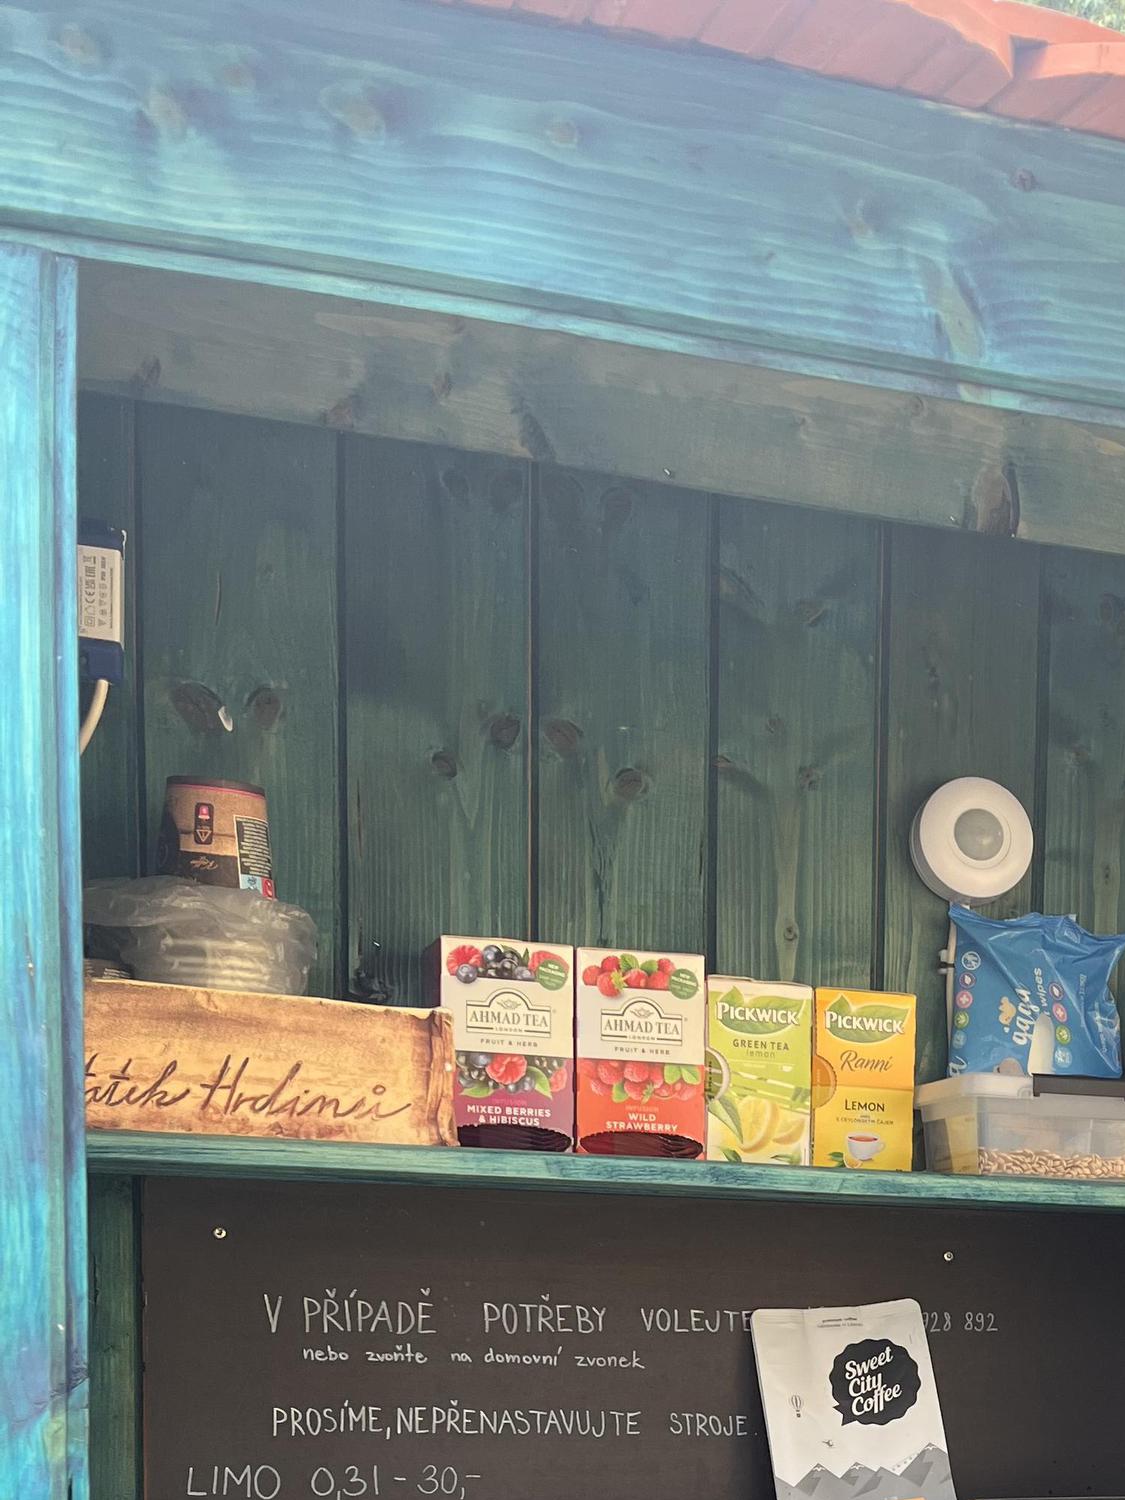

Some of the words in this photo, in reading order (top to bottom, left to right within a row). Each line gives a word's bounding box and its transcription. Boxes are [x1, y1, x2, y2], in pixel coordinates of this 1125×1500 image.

[470, 1010, 521, 1027] AHMAD
[523, 1013, 549, 1028] TEA
[717, 1002, 799, 1026] PICKWICK
[825, 1011, 904, 1034] PICKWICK
[604, 1018, 652, 1034] AHMAD
[655, 1021, 680, 1036] TEA
[480, 1038, 505, 1046] FRUIT
[614, 1046, 638, 1054] FRUIT
[733, 1038, 767, 1050] GREEN
[770, 1041, 789, 1051] TEA
[746, 1049, 776, 1059] lemon
[840, 1050, 893, 1072] Ranní
[467, 1104, 502, 1115] MIXED
[506, 1106, 551, 1118] BERRIES
[844, 1099, 885, 1112] LEMON
[478, 1115, 485, 1123] &
[489, 1116, 540, 1127] HIBISCUS
[628, 1112, 656, 1122] WILD
[606, 1121, 678, 1132] STRAWBERRY
[263, 1293, 283, 1333] V
[303, 1287, 437, 1334] PŘÍPADĚ
[482, 1293, 607, 1334] POTŘEBY
[641, 1307, 752, 1334] VOLEJTE
[964, 1311, 999, 1332] 892
[303, 1346, 349, 1362] nebo
[366, 1344, 428, 1365] zvoňte
[451, 1351, 473, 1363] na
[484, 1346, 564, 1367] domovní
[574, 1350, 645, 1369] zvonek
[844, 1346, 894, 1381] Sweet
[848, 1373, 883, 1398] City
[851, 1381, 903, 1417] Coffee
[187, 1464, 281, 1500] LIMO
